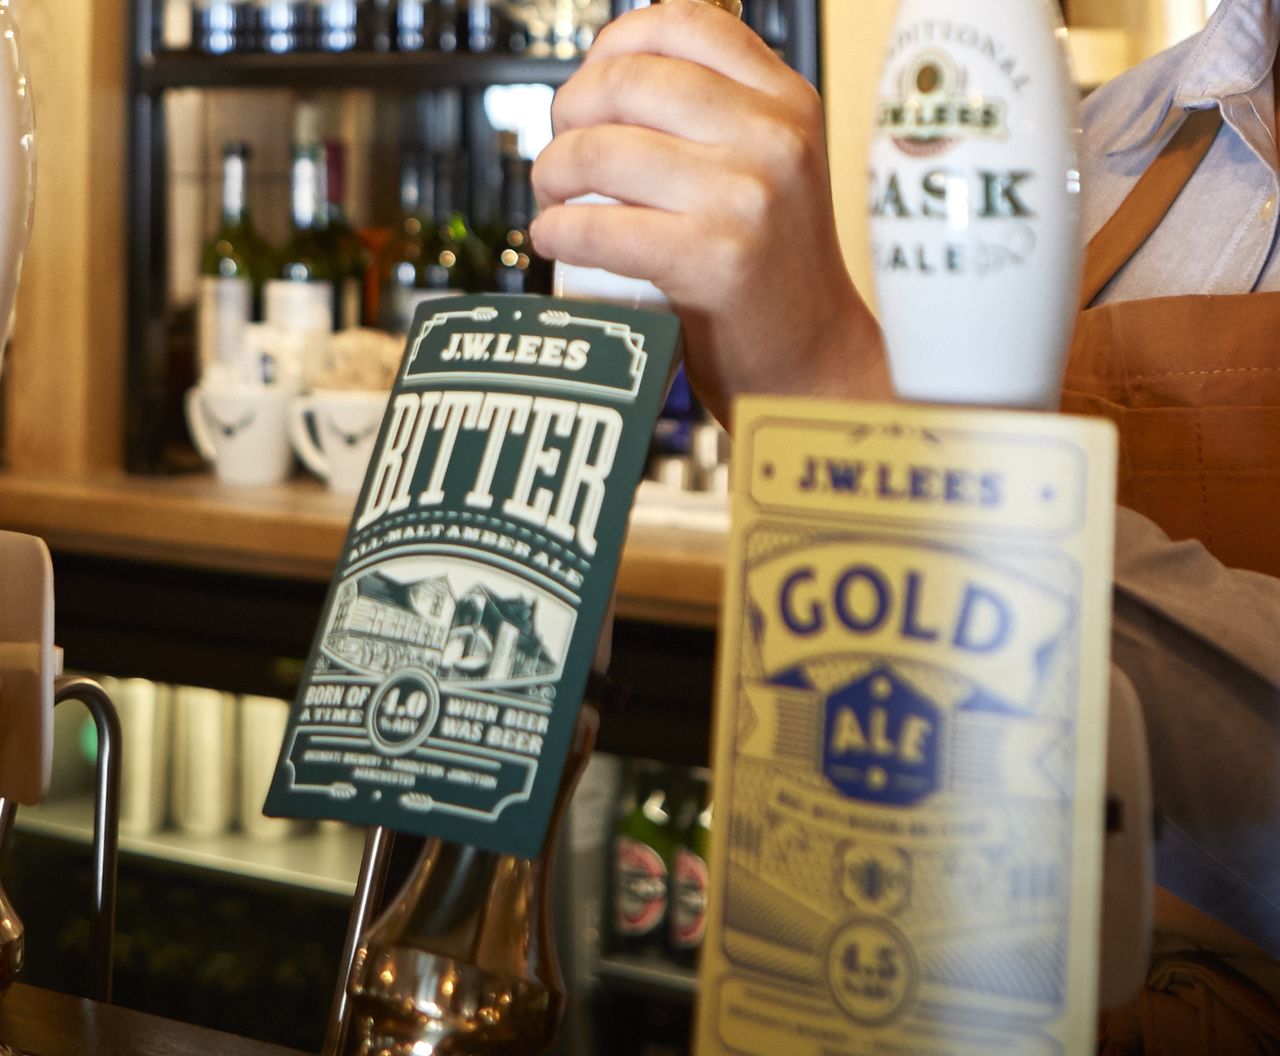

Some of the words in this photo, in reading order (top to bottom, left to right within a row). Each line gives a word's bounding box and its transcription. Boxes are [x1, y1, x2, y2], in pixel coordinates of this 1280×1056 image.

[440, 332, 591, 371] J.W.LEES
[356, 391, 624, 557] BITTER
[532, 551, 584, 590] ALE
[779, 563, 1015, 656] GOLD
[304, 685, 345, 707] BORN
[345, 686, 371, 707] OF
[446, 697, 499, 723] WHEN
[502, 706, 549, 734] BEER
[440, 717, 485, 743] WAS
[486, 726, 543, 754] BEER
[831, 706, 934, 764] ALE
